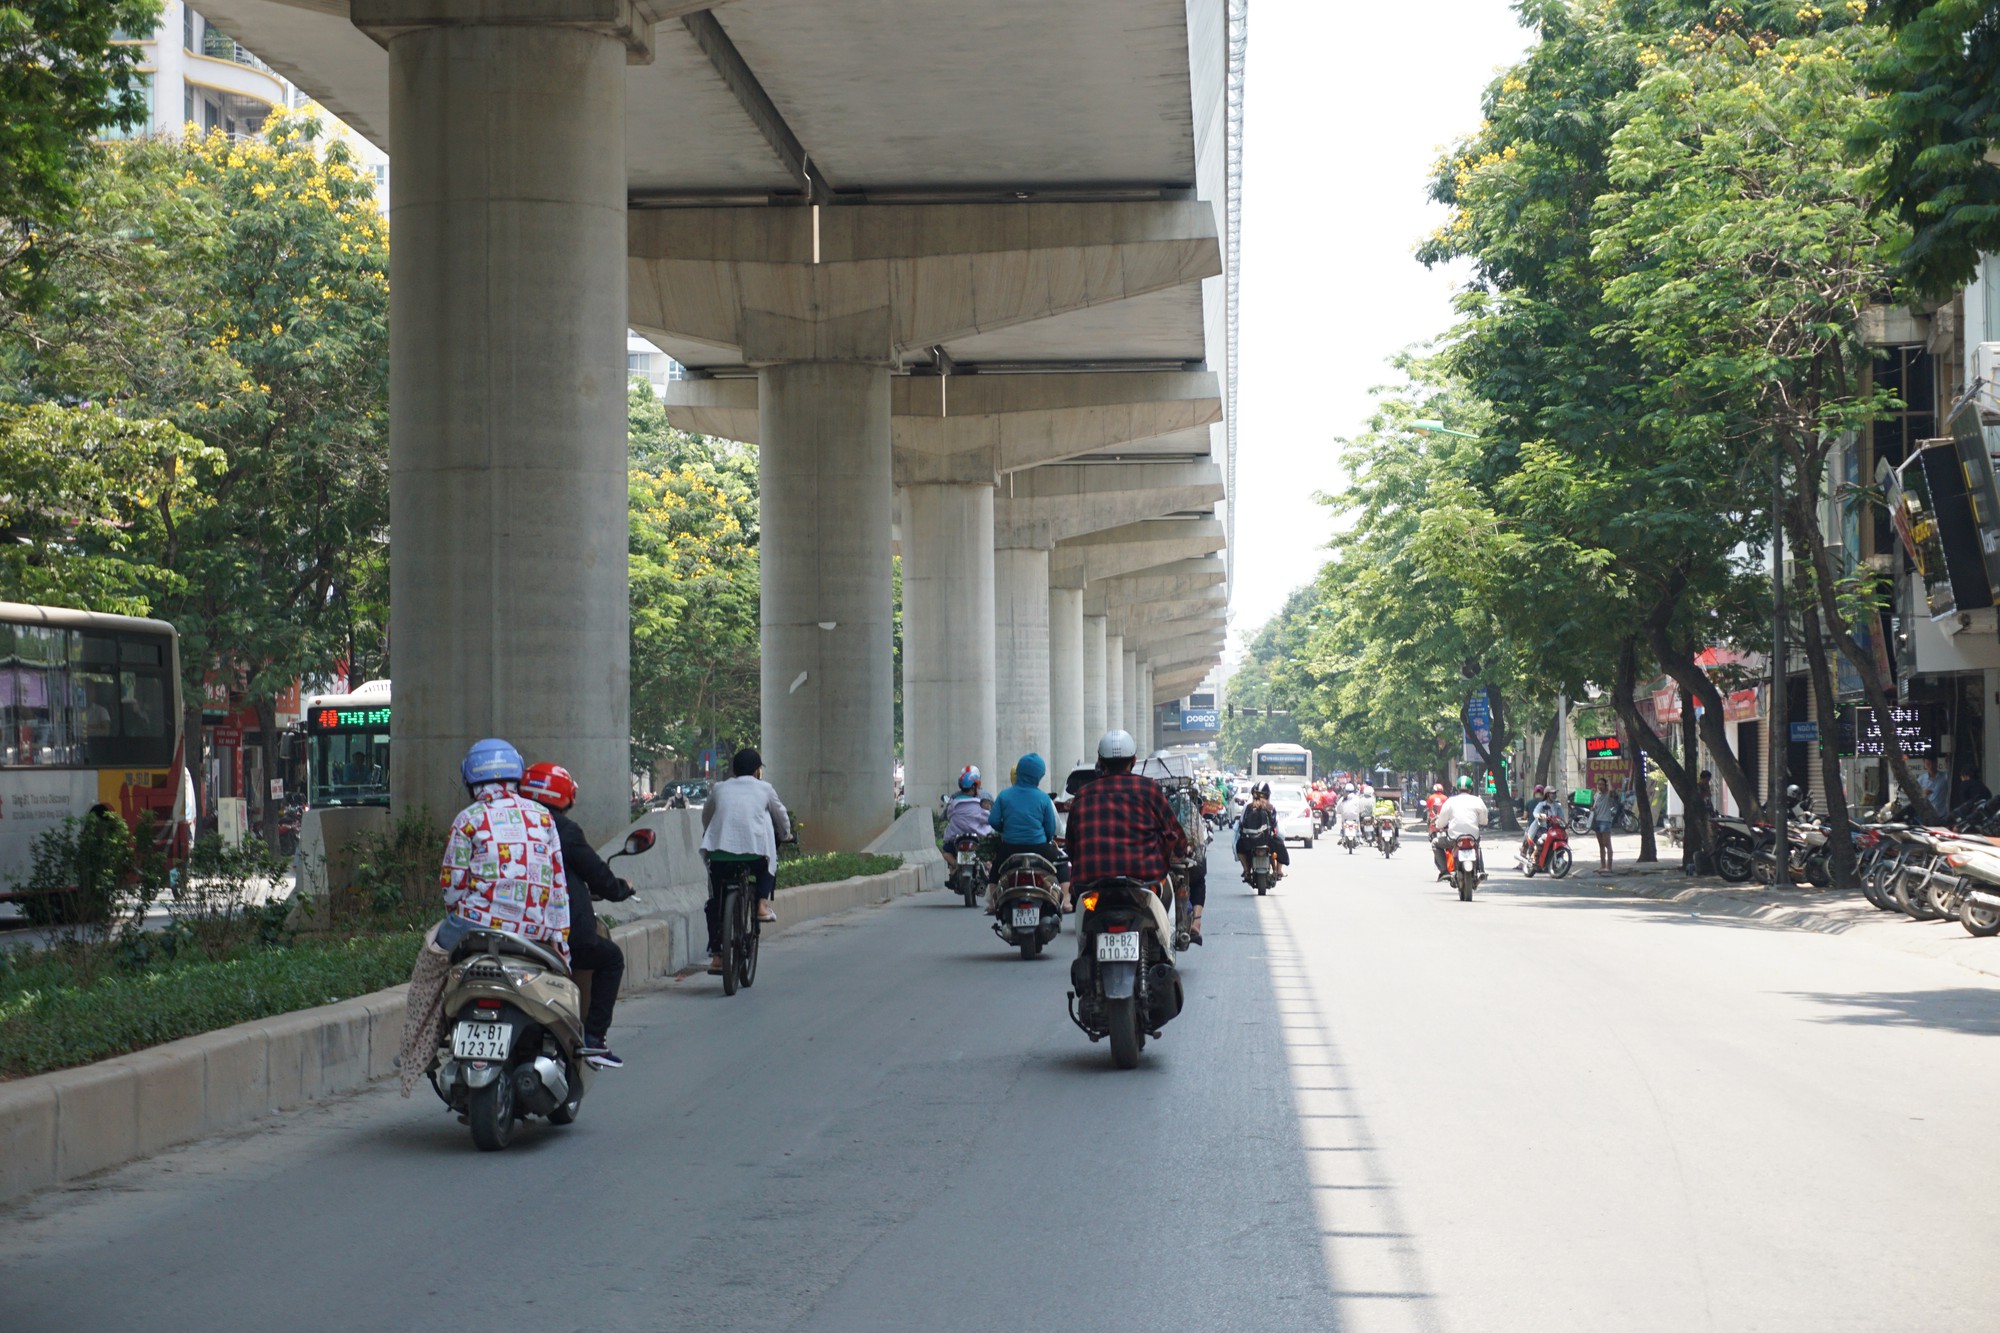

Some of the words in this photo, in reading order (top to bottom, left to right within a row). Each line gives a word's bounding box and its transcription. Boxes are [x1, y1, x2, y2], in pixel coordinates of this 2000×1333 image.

[1104, 935, 1132, 947] 18-B2
[1100, 948, 1136, 960] 010.32
[467, 1024, 502, 1040] 74-B1
[460, 1041, 505, 1058] 123.74
